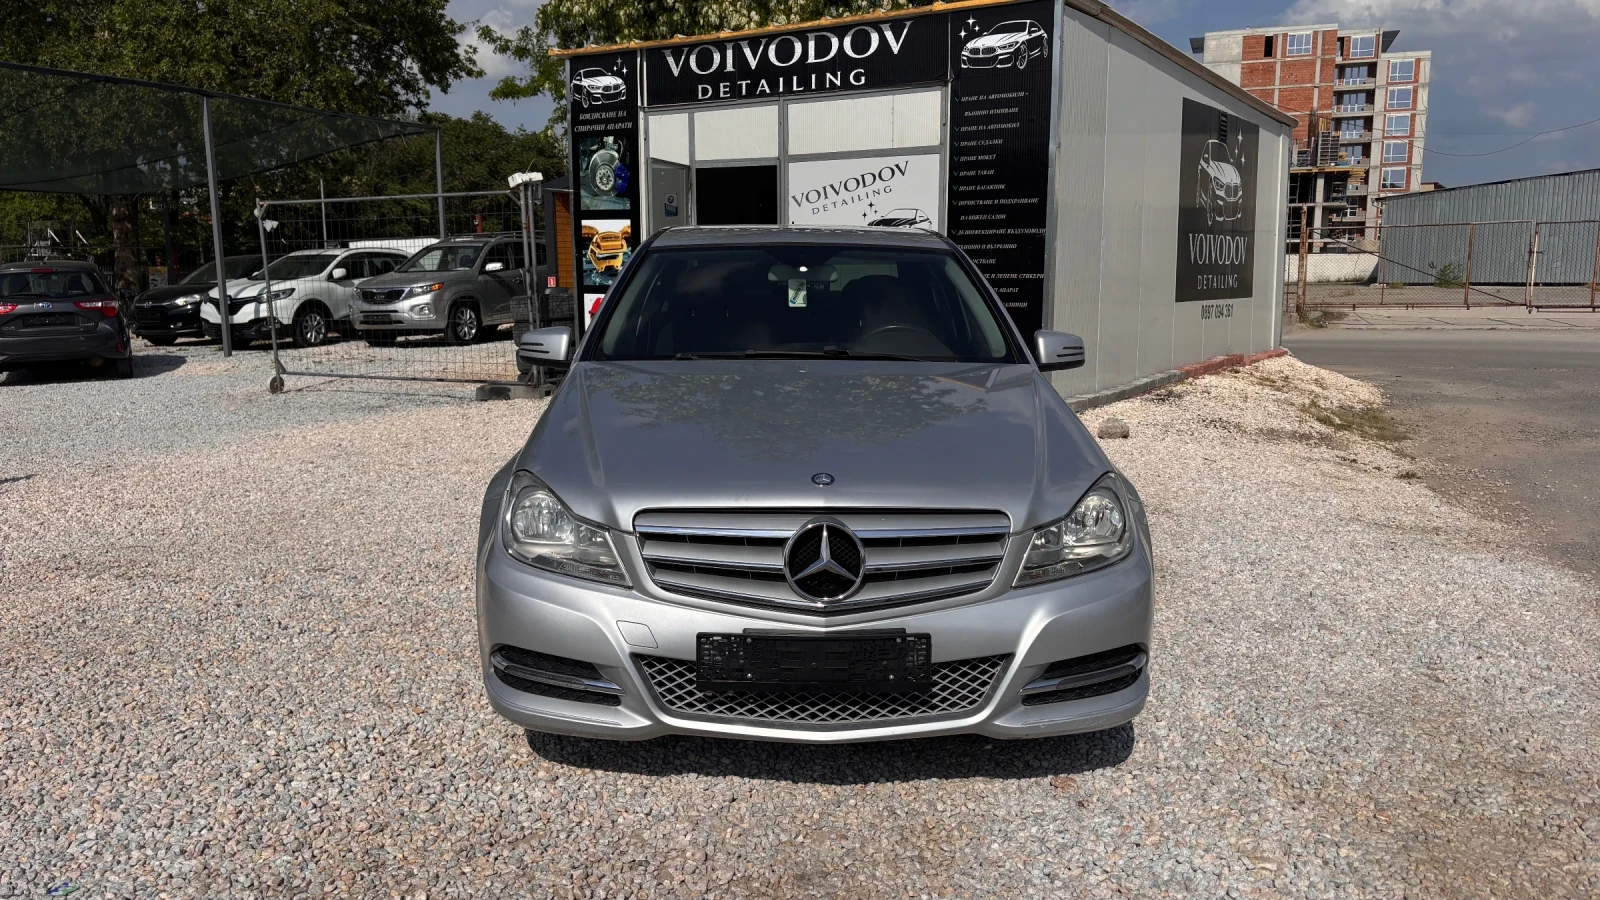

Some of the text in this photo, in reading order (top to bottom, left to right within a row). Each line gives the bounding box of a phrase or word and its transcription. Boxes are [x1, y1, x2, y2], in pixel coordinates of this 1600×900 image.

[662, 20, 914, 78] VOIVODOV
[697, 68, 867, 100] DETAILING
[574, 121, 633, 132] СПИРАЧНИ АПАРАТИ
[579, 110, 627, 120] БОЯДИСВАНЕ НА
[791, 160, 909, 208] VOIVODOV
[812, 185, 892, 215] DETAILING
[1188, 233, 1248, 265] VOIVODOV
[1197, 274, 1238, 290] DETAILING
